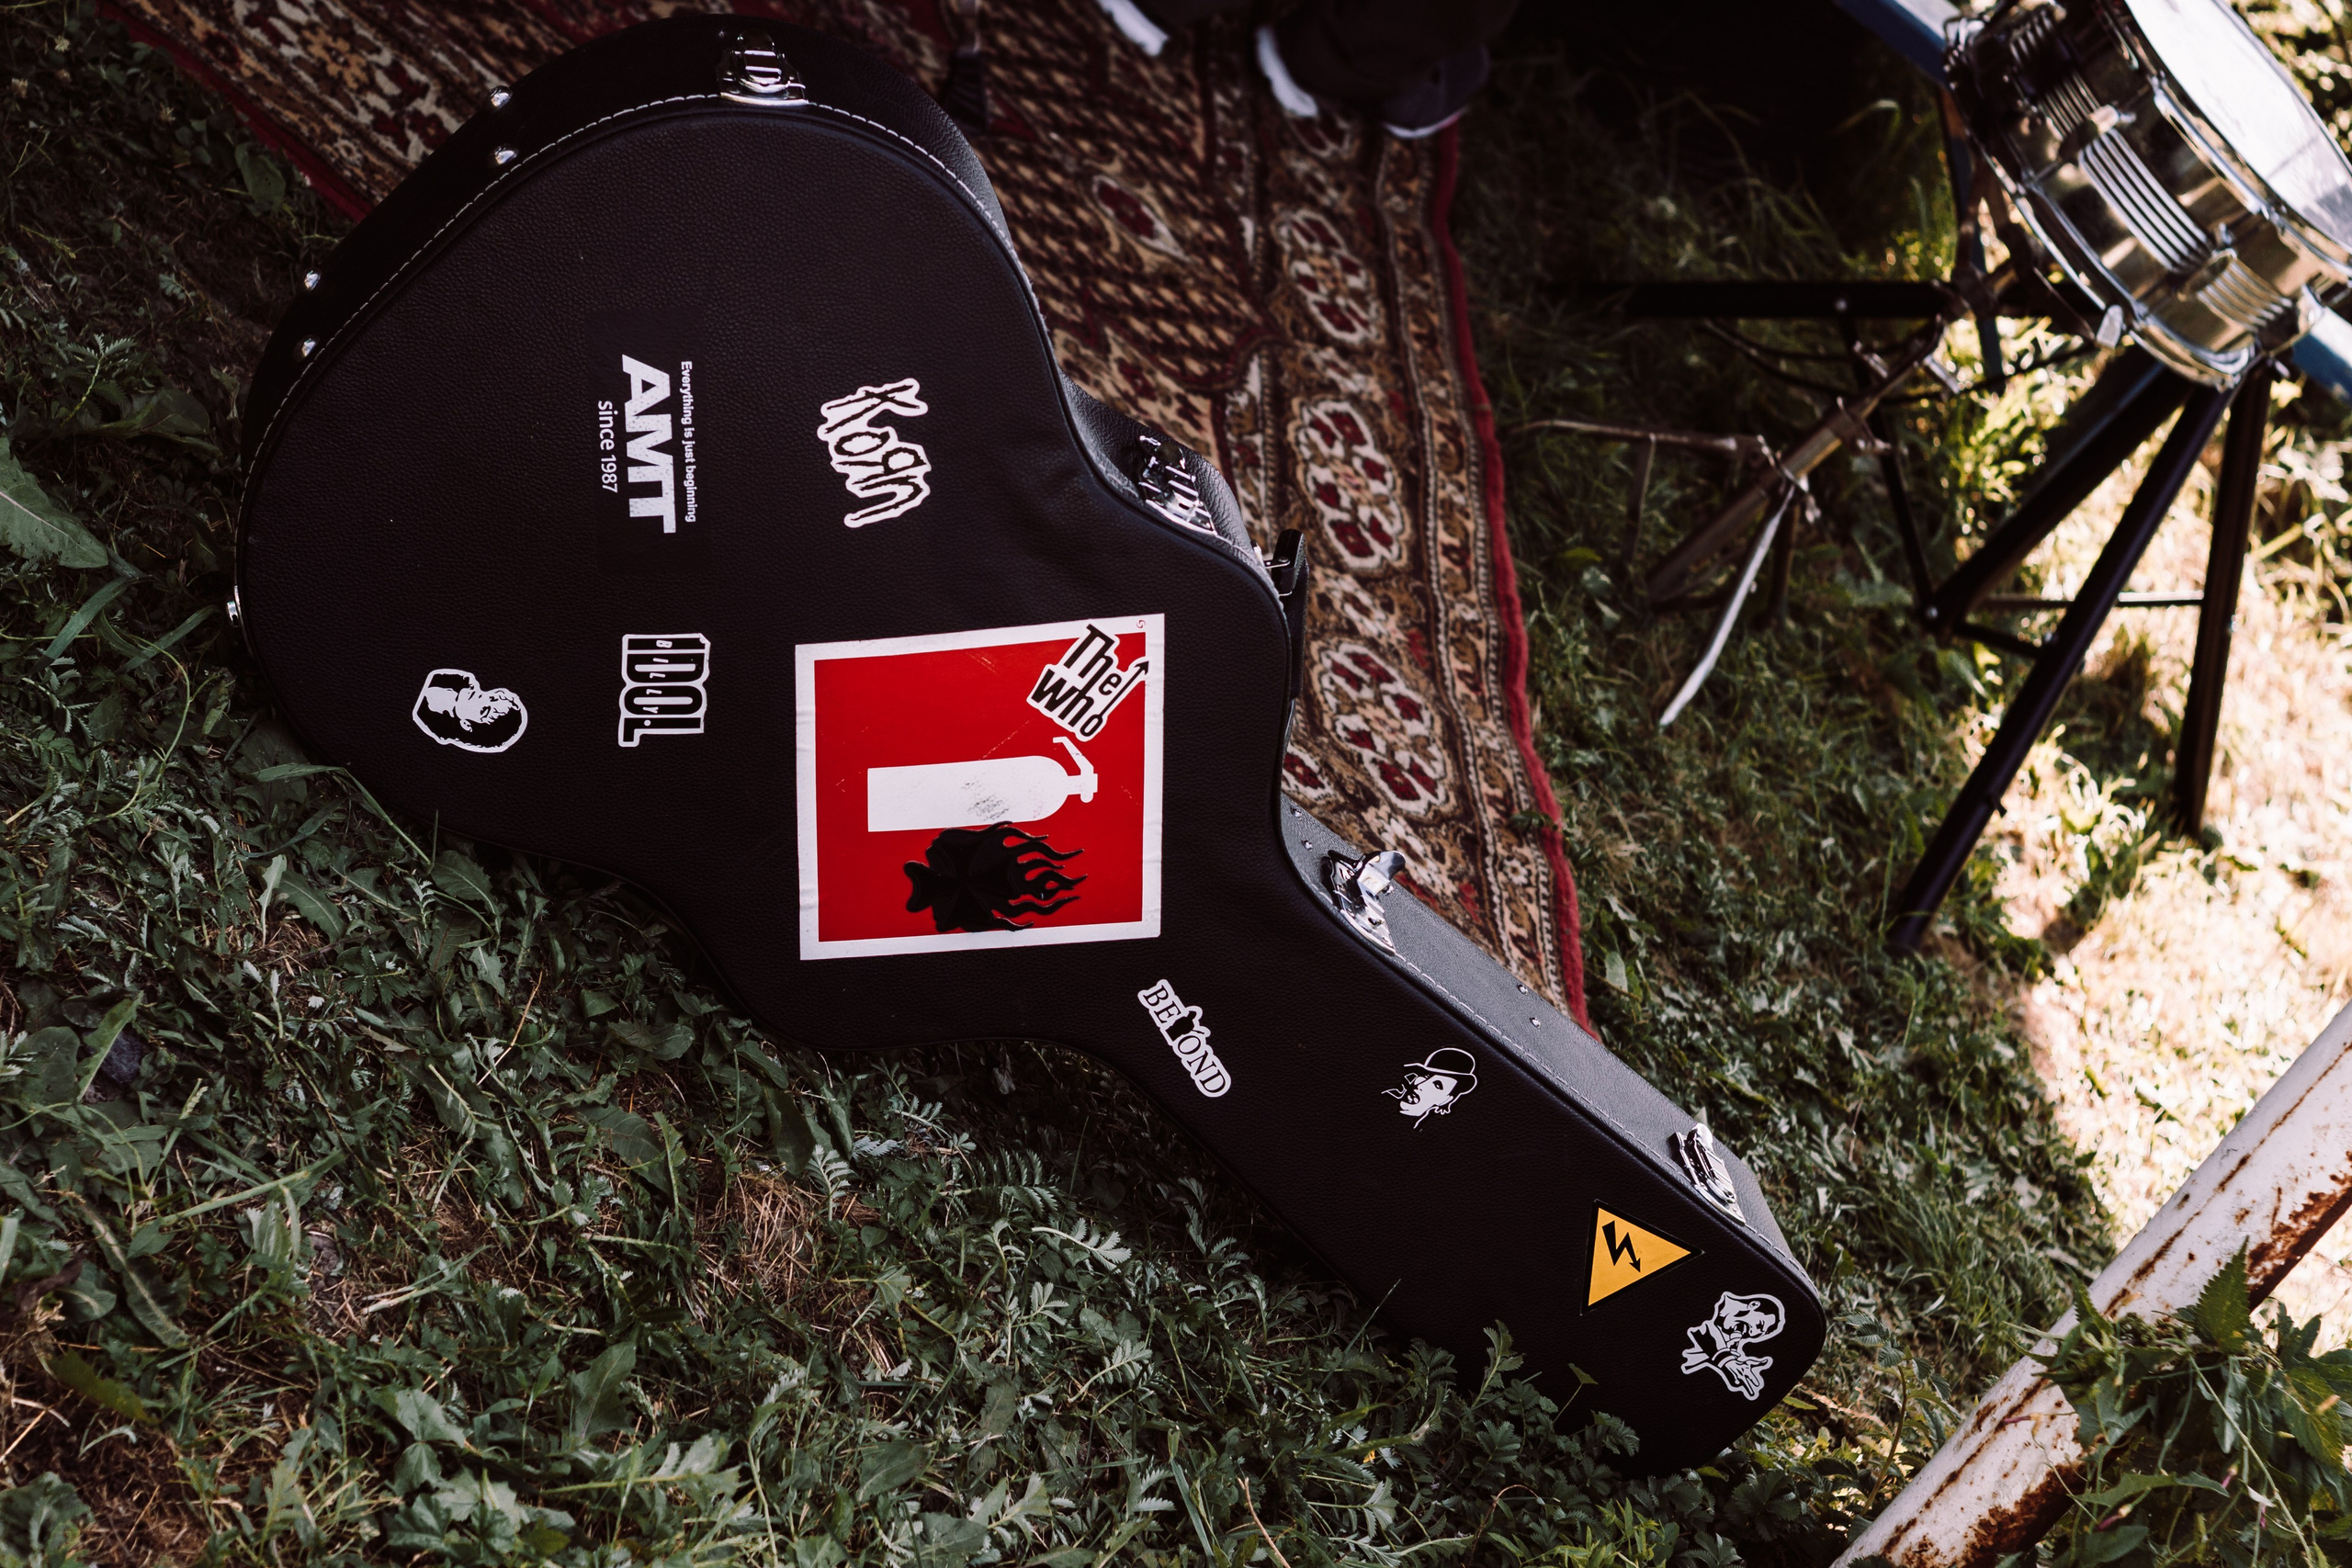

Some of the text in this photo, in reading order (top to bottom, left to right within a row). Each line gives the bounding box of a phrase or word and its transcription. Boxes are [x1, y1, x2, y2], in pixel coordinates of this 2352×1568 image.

[598, 400, 618, 493] since 1987
[622, 354, 676, 534] AMT
[680, 360, 698, 523] Everything is just beginning
[621, 636, 707, 744] IDOL
[1063, 623, 1123, 696] The
[1142, 984, 1227, 1094] BEOND
